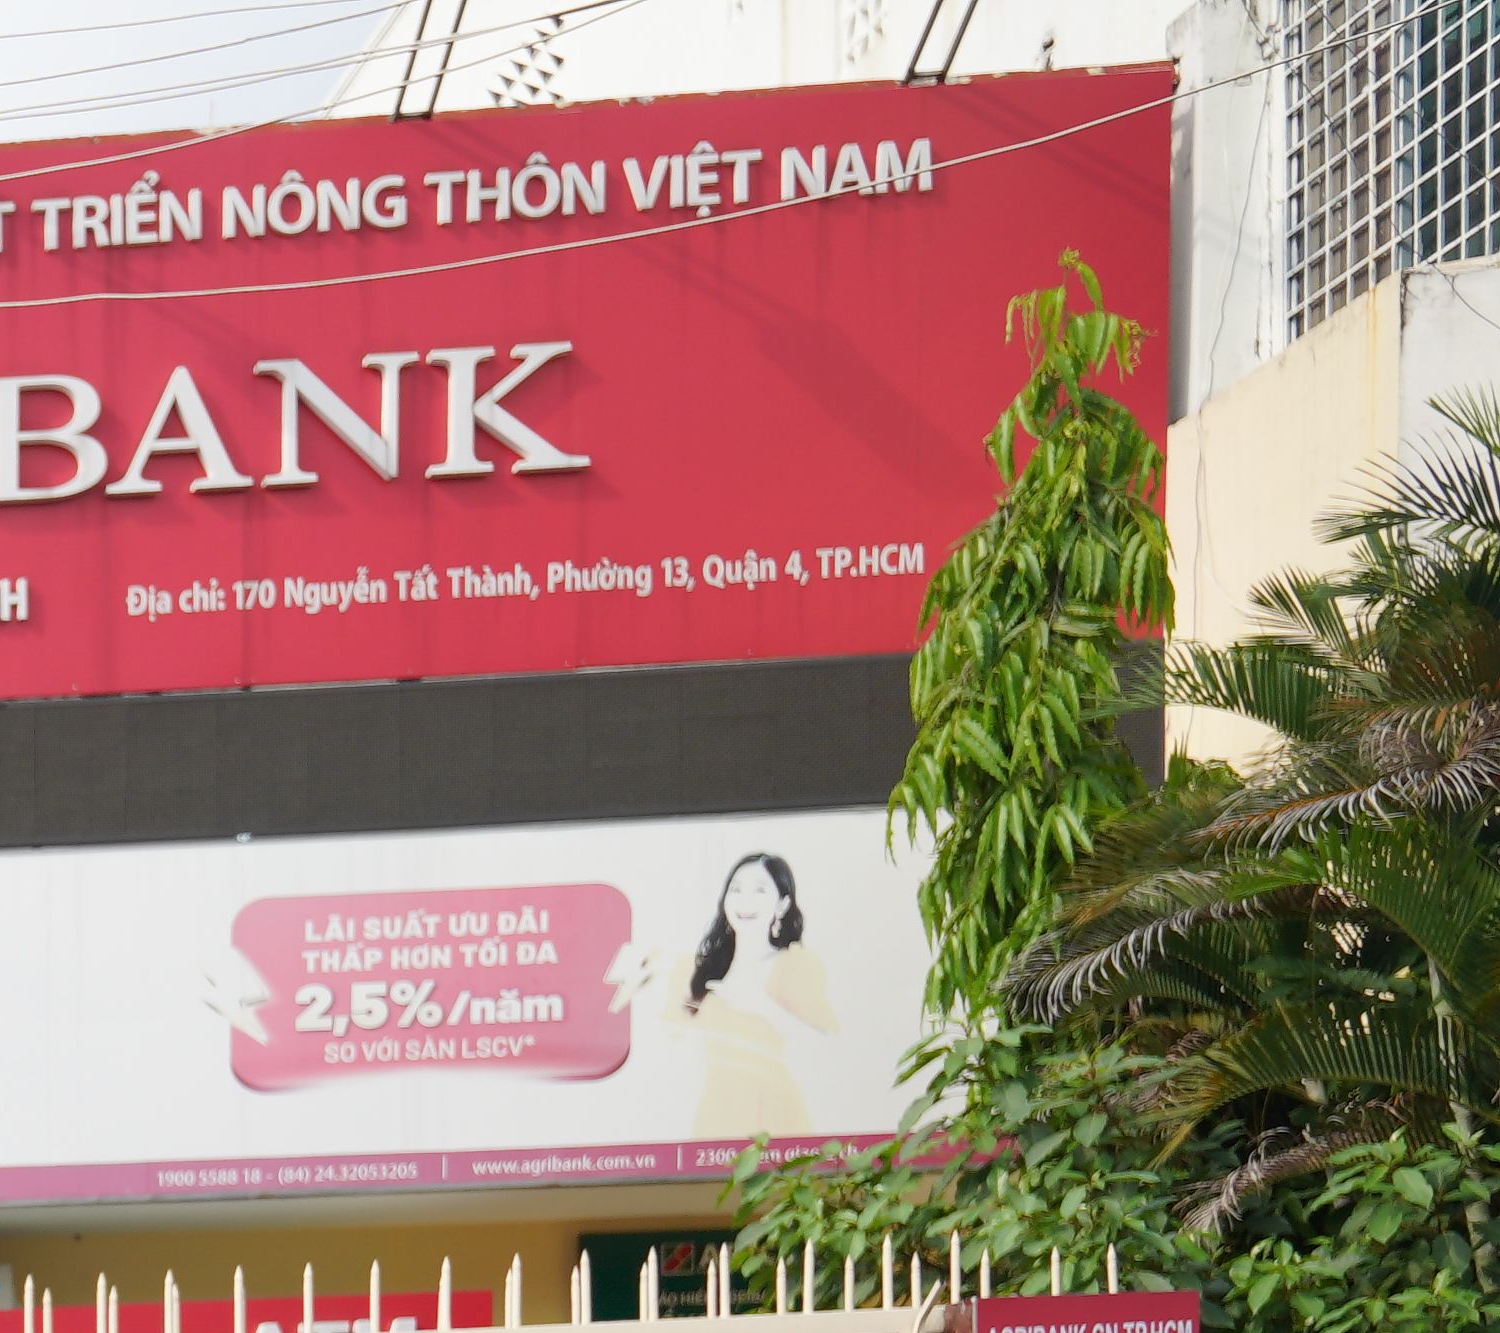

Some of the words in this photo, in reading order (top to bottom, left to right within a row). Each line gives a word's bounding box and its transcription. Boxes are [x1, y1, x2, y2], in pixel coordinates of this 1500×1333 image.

[31, 172, 202, 253] TRIỂN
[221, 170, 408, 240] NÔNG
[423, 151, 607, 226] THÔN
[623, 141, 761, 219] VIỆT
[781, 138, 933, 200] NAM
[126, 585, 172, 621] Địa
[233, 578, 275, 610] 170
[285, 565, 387, 613] Nguyễn
[393, 565, 438, 602] Tất
[447, 562, 540, 602] Thành,
[547, 561, 653, 598] Phường
[661, 557, 695, 592] 13,
[702, 549, 776, 588] Quận
[784, 550, 809, 586] 4,
[817, 543, 925, 580] TP.HCM
[304, 913, 355, 942] LÃI
[363, 908, 440, 939] SUẤT
[449, 910, 490, 937] ƯU
[497, 905, 548, 934] ĐÃI
[301, 942, 383, 973] THẤP
[390, 944, 452, 970] HƠN
[460, 936, 508, 967] TỐI
[516, 941, 557, 965] ĐA
[324, 1040, 357, 1064] SO
[361, 1036, 399, 1061] VỚI
[157, 1170, 195, 1187] 1900
[472, 1152, 655, 1177] www.agribank.com.vn
